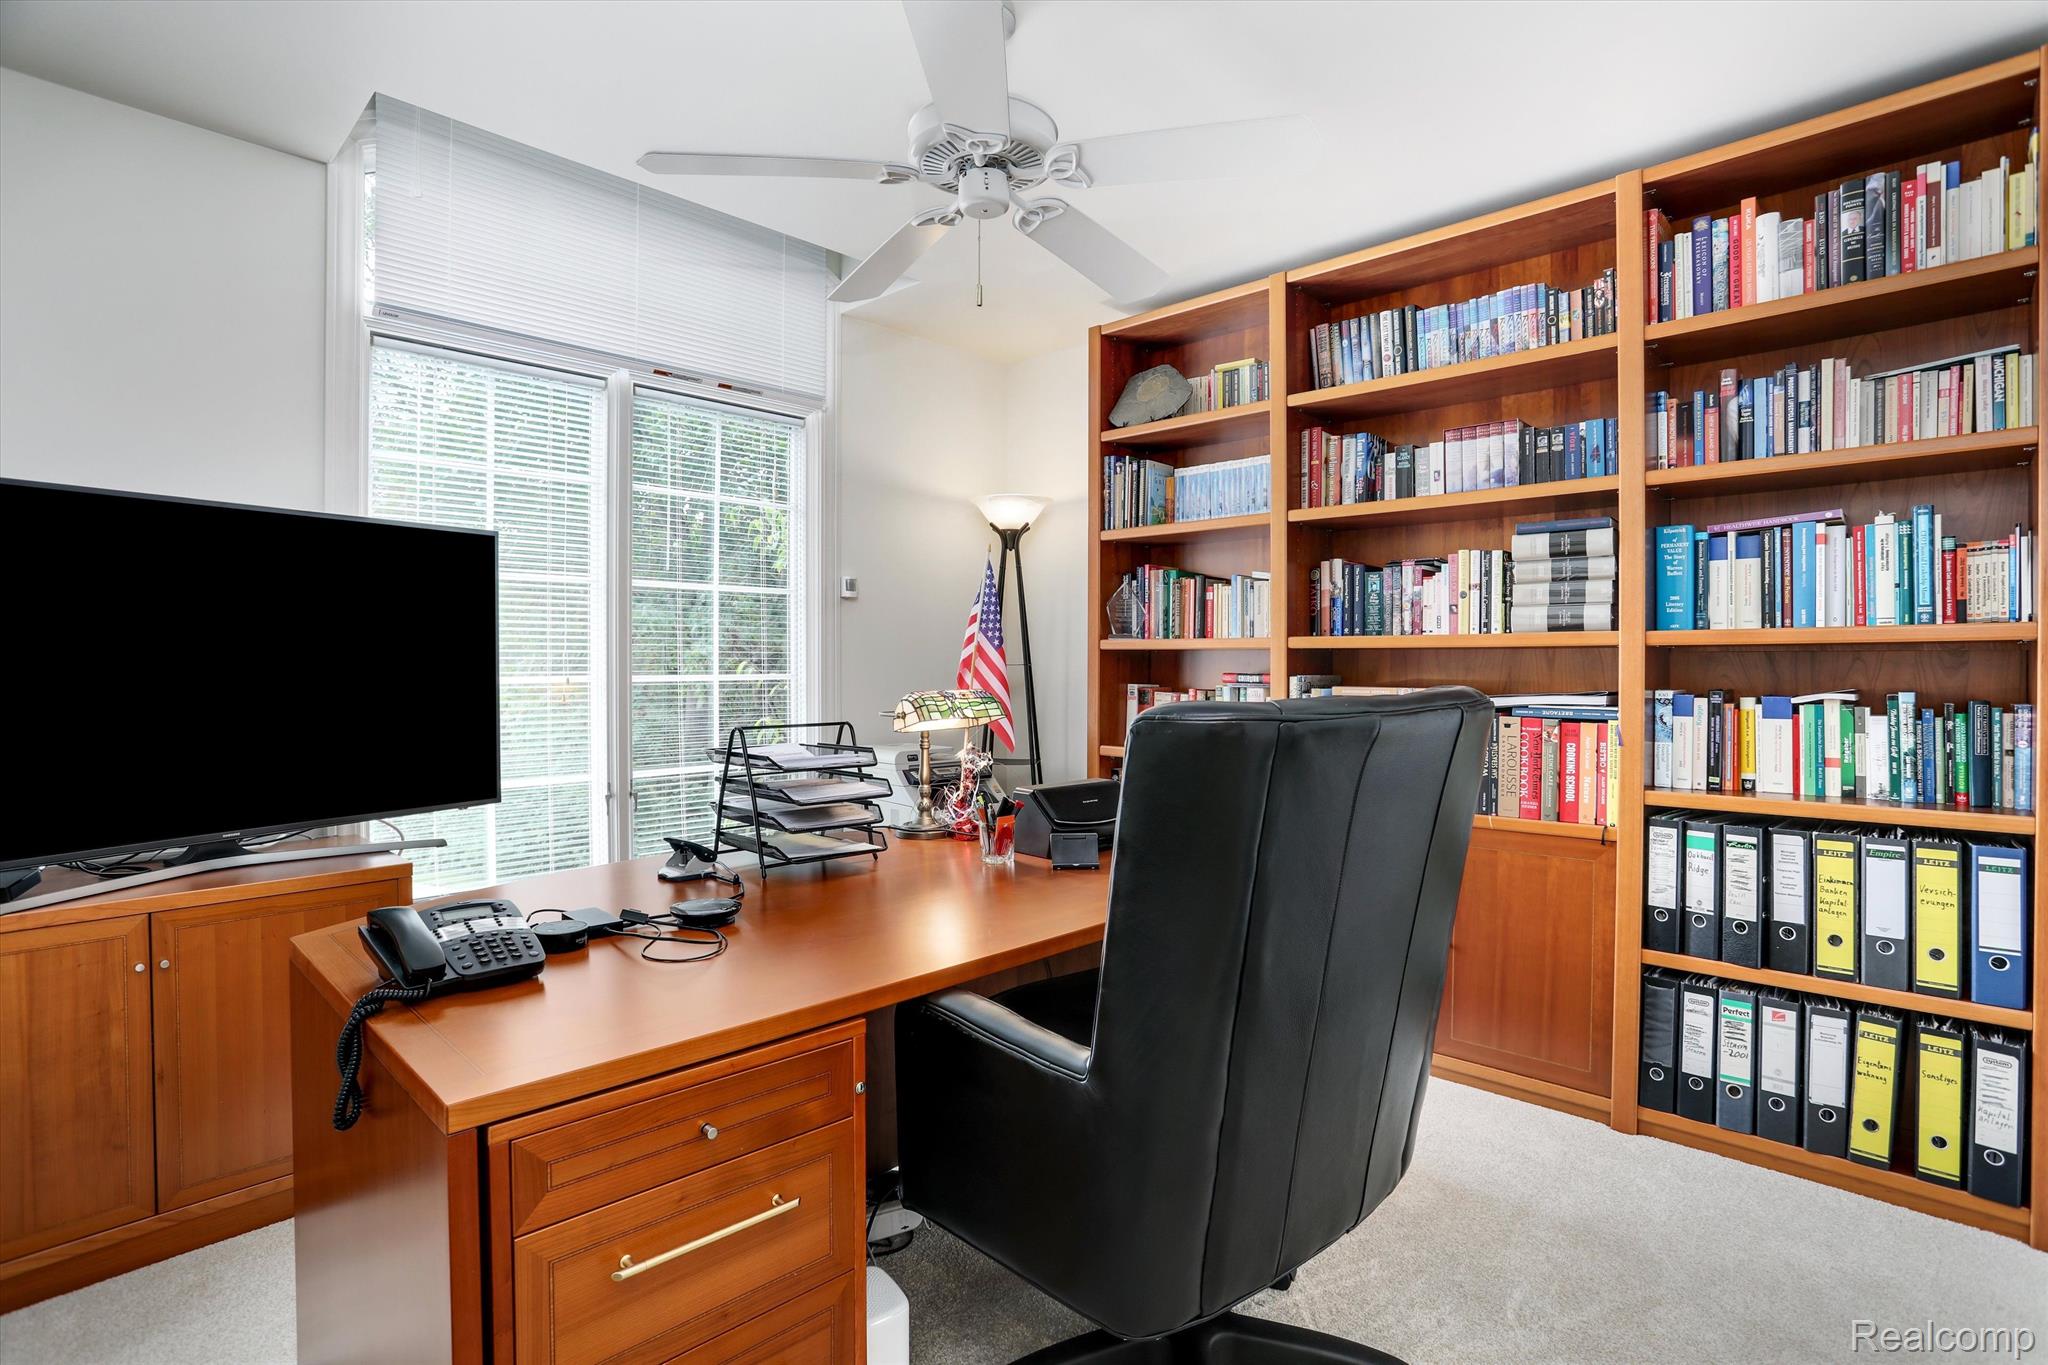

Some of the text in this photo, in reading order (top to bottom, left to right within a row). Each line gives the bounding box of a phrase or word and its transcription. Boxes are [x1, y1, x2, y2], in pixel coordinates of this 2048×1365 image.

[1702, 268, 1708, 277] OF
[1734, 264, 1740, 274] TO
[1994, 358, 2005, 402] MICHIGAN
[1787, 376, 1795, 454] PRODUCT LIFECYCLE MANAGEMENT
[1723, 516, 1800, 531] HEALTHWISE HANDBOOK
[1784, 547, 1792, 604] INVENTORY Best Practices
[1506, 735, 1517, 798] LAROUSSE
[1531, 732, 1542, 800] New York Times
[1565, 742, 1577, 803] COOKING SCHOOL
[1823, 850, 1848, 858] LEITZ
[1868, 850, 1901, 859] Empire
[1923, 858, 1952, 867] LEITZ
[1687, 861, 1710, 877] Ridge
[1985, 865, 2014, 874] LEITZ
[1819, 874, 1855, 886] Einkommen
[1819, 885, 1848, 897] Banken
[1818, 906, 1848, 919] anlagen
[1722, 1006, 1751, 1018] Perfect
[1864, 1031, 1890, 1043] LEITZ
[1927, 1045, 1955, 1056] LEITZ
[1985, 1058, 2011, 1067] system
[1921, 1070, 1958, 1086] Sonstiges
